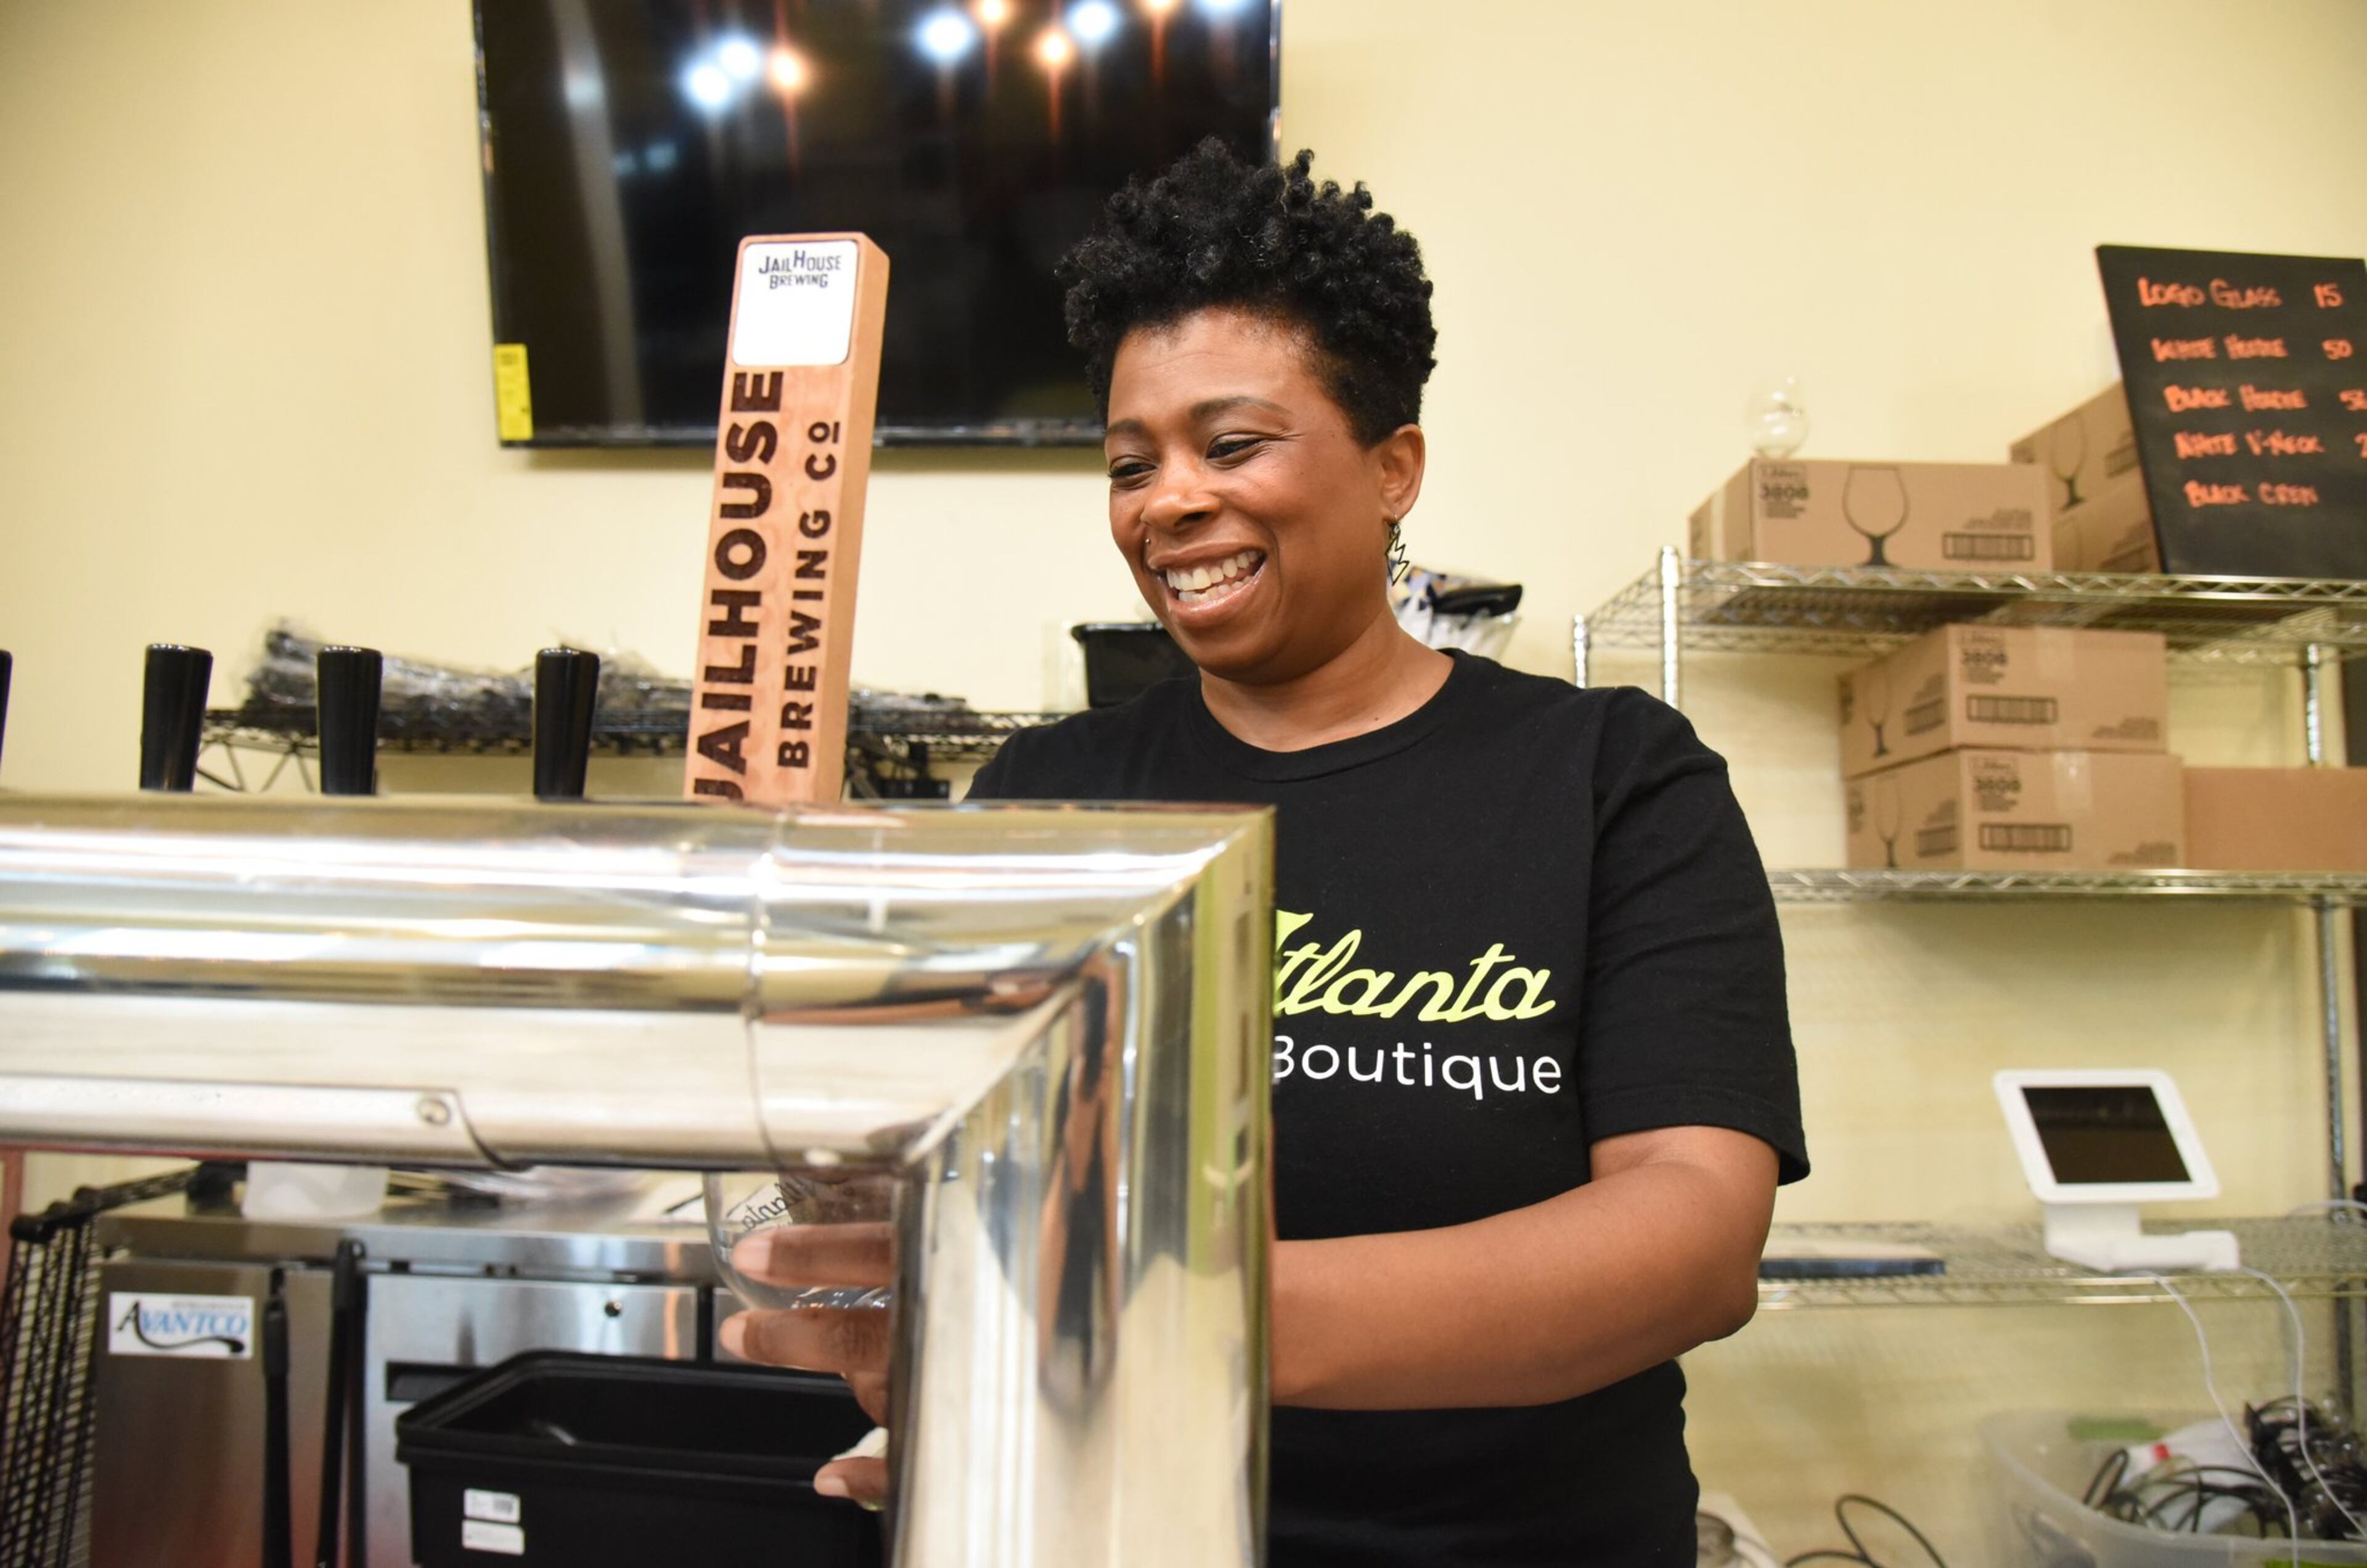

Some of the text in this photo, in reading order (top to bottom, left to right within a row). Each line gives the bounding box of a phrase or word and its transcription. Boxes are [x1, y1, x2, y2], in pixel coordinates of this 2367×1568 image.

[769, 274, 828, 289] BREWING
[2314, 284, 2342, 307] 15
[2322, 340, 2352, 359] 50
[777, 508, 832, 769] BREWING
[117, 1300, 247, 1351] AVANTCO
